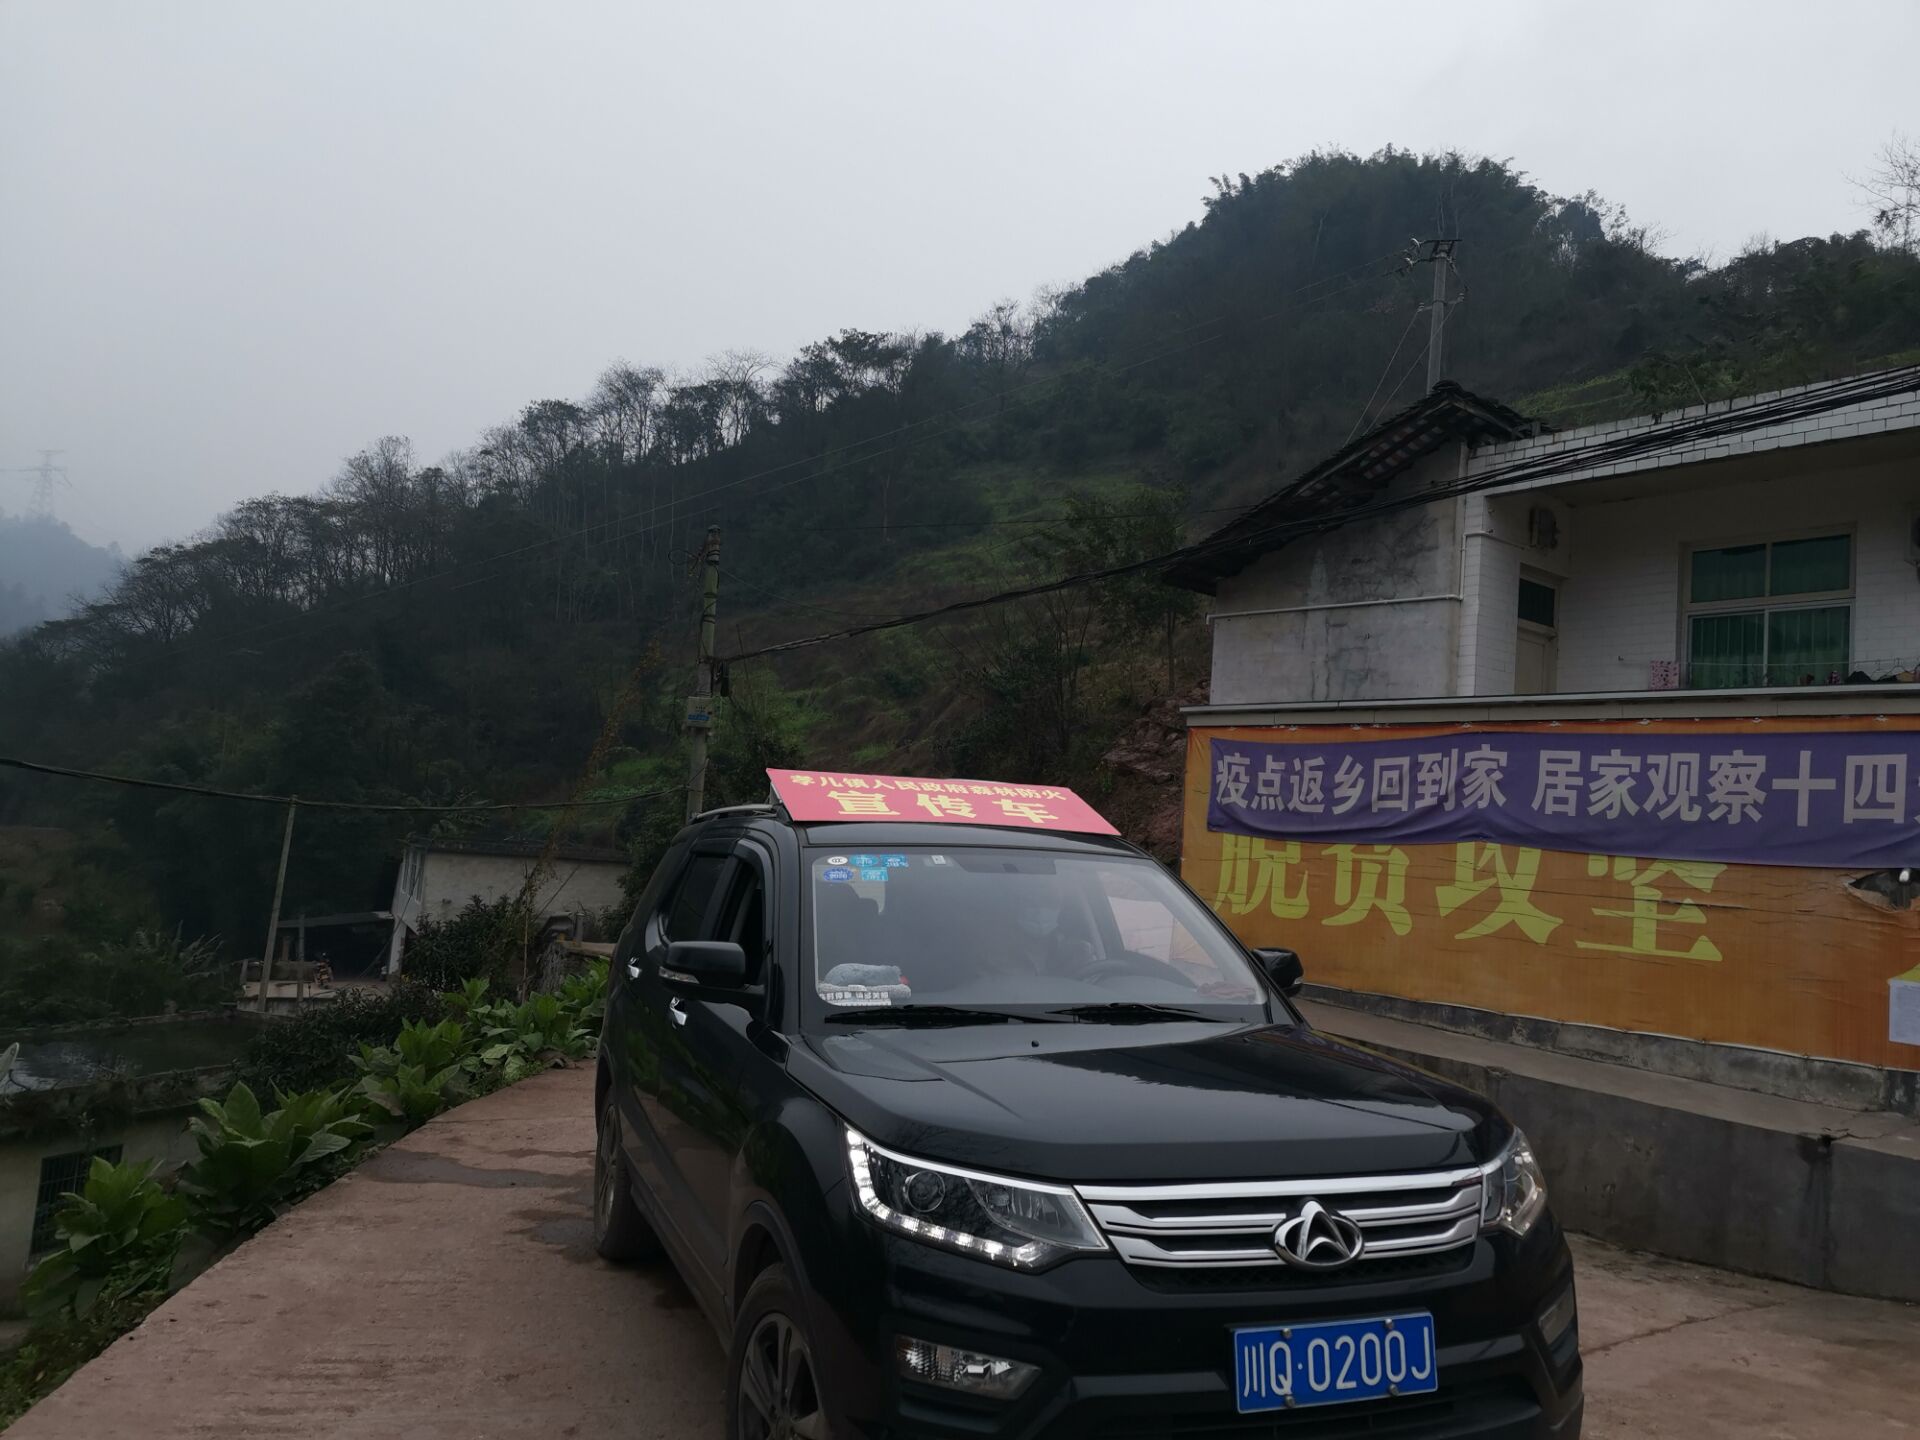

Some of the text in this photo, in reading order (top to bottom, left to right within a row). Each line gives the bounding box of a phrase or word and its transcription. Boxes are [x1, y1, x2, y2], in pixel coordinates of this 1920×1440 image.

[827, 790, 1060, 824] 宣传车
[1215, 744, 1920, 827] 疫点返乡回到家 居家观察十四
[1243, 1326, 1432, 1399] 川Q·0200J
